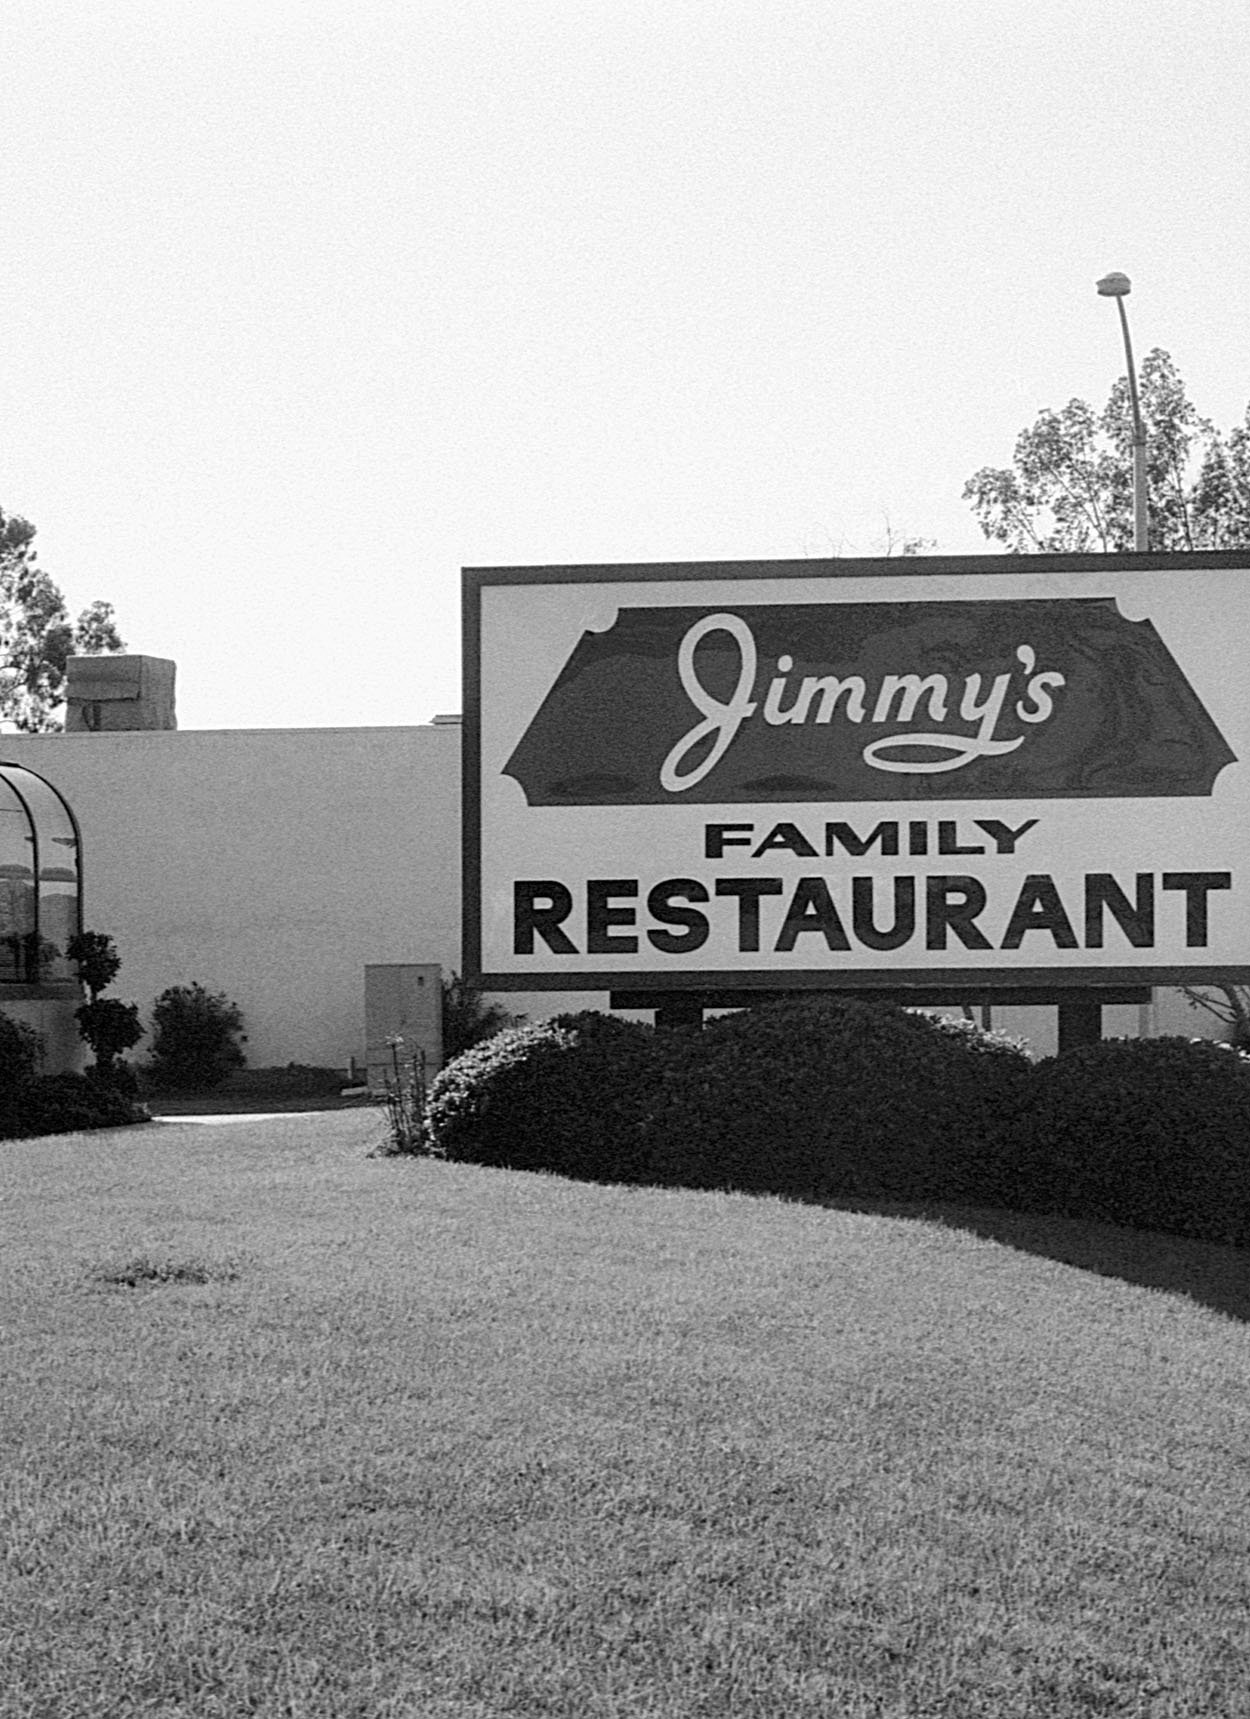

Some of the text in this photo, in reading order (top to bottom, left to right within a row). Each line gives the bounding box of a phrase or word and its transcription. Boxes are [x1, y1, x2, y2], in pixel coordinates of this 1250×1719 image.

[660, 612, 1066, 792] Jimmy's
[703, 818, 1041, 859] FAMILY
[512, 871, 1233, 956] RESTAURANT
